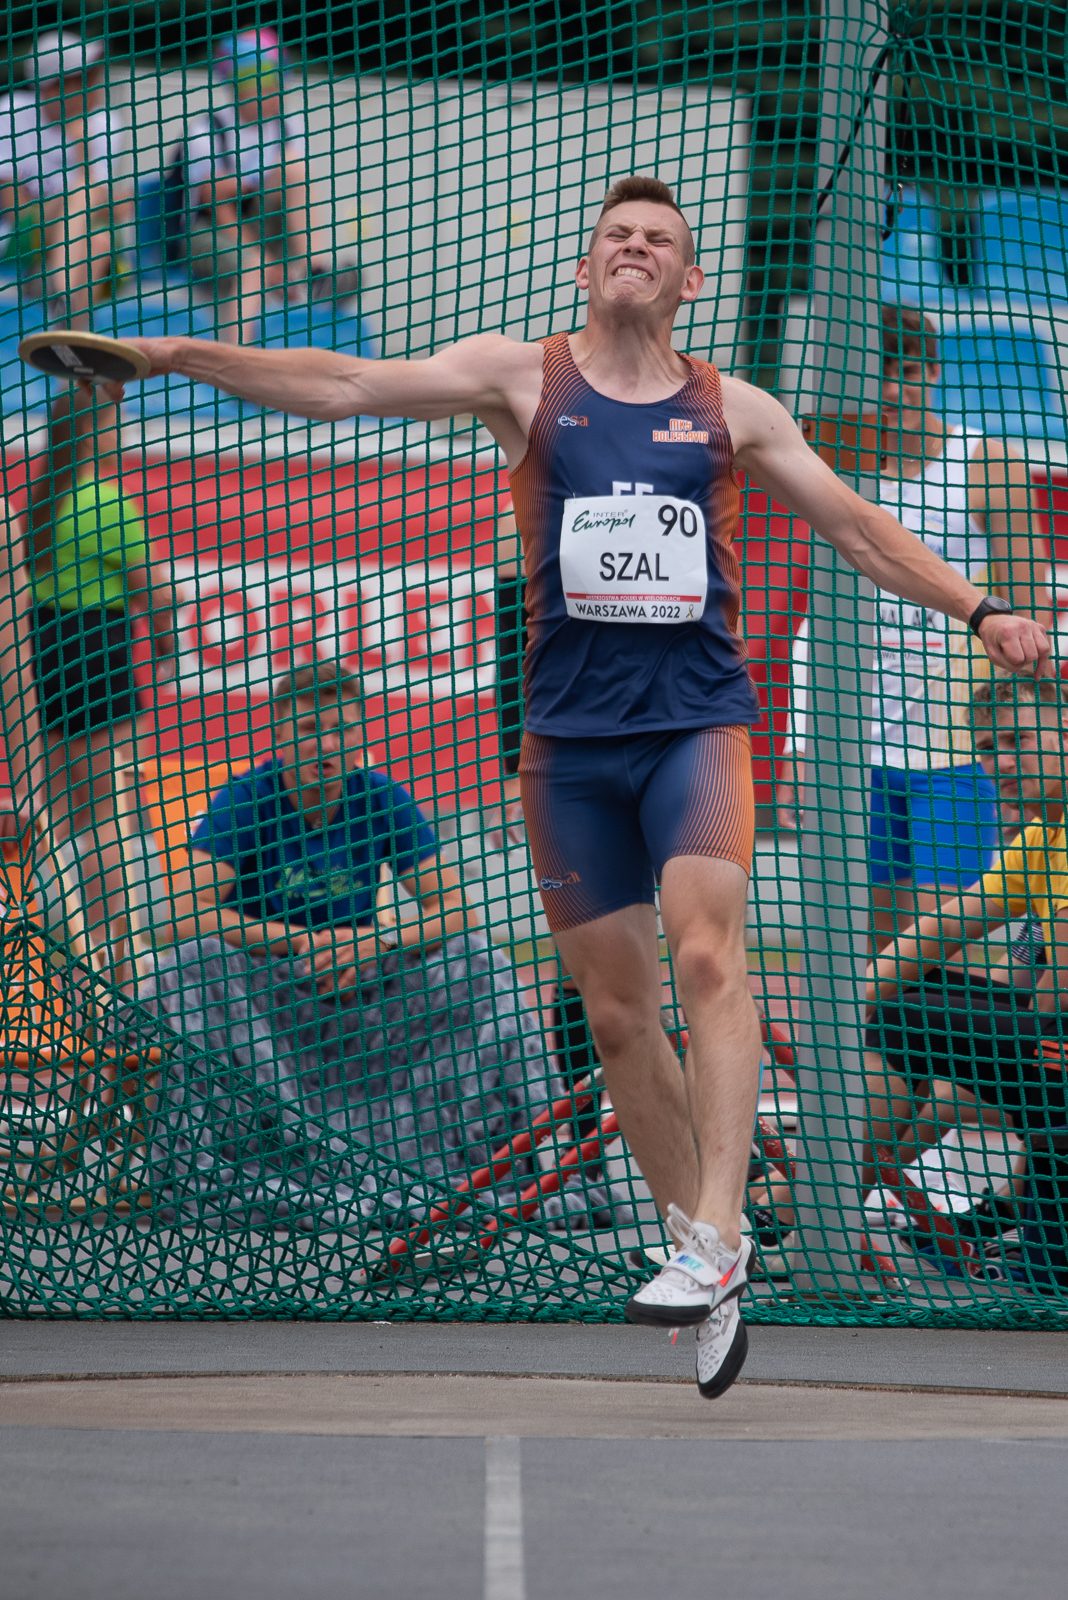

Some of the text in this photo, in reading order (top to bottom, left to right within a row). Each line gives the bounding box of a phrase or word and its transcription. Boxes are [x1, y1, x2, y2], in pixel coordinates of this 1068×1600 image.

[669, 418, 693, 431] MKS
[571, 510, 636, 534] Europol
[657, 504, 698, 538] 90
[599, 552, 670, 582] SZAL
[575, 603, 681, 619] WARSZAWA 2022
[673, 1254, 705, 1273] NIKE
